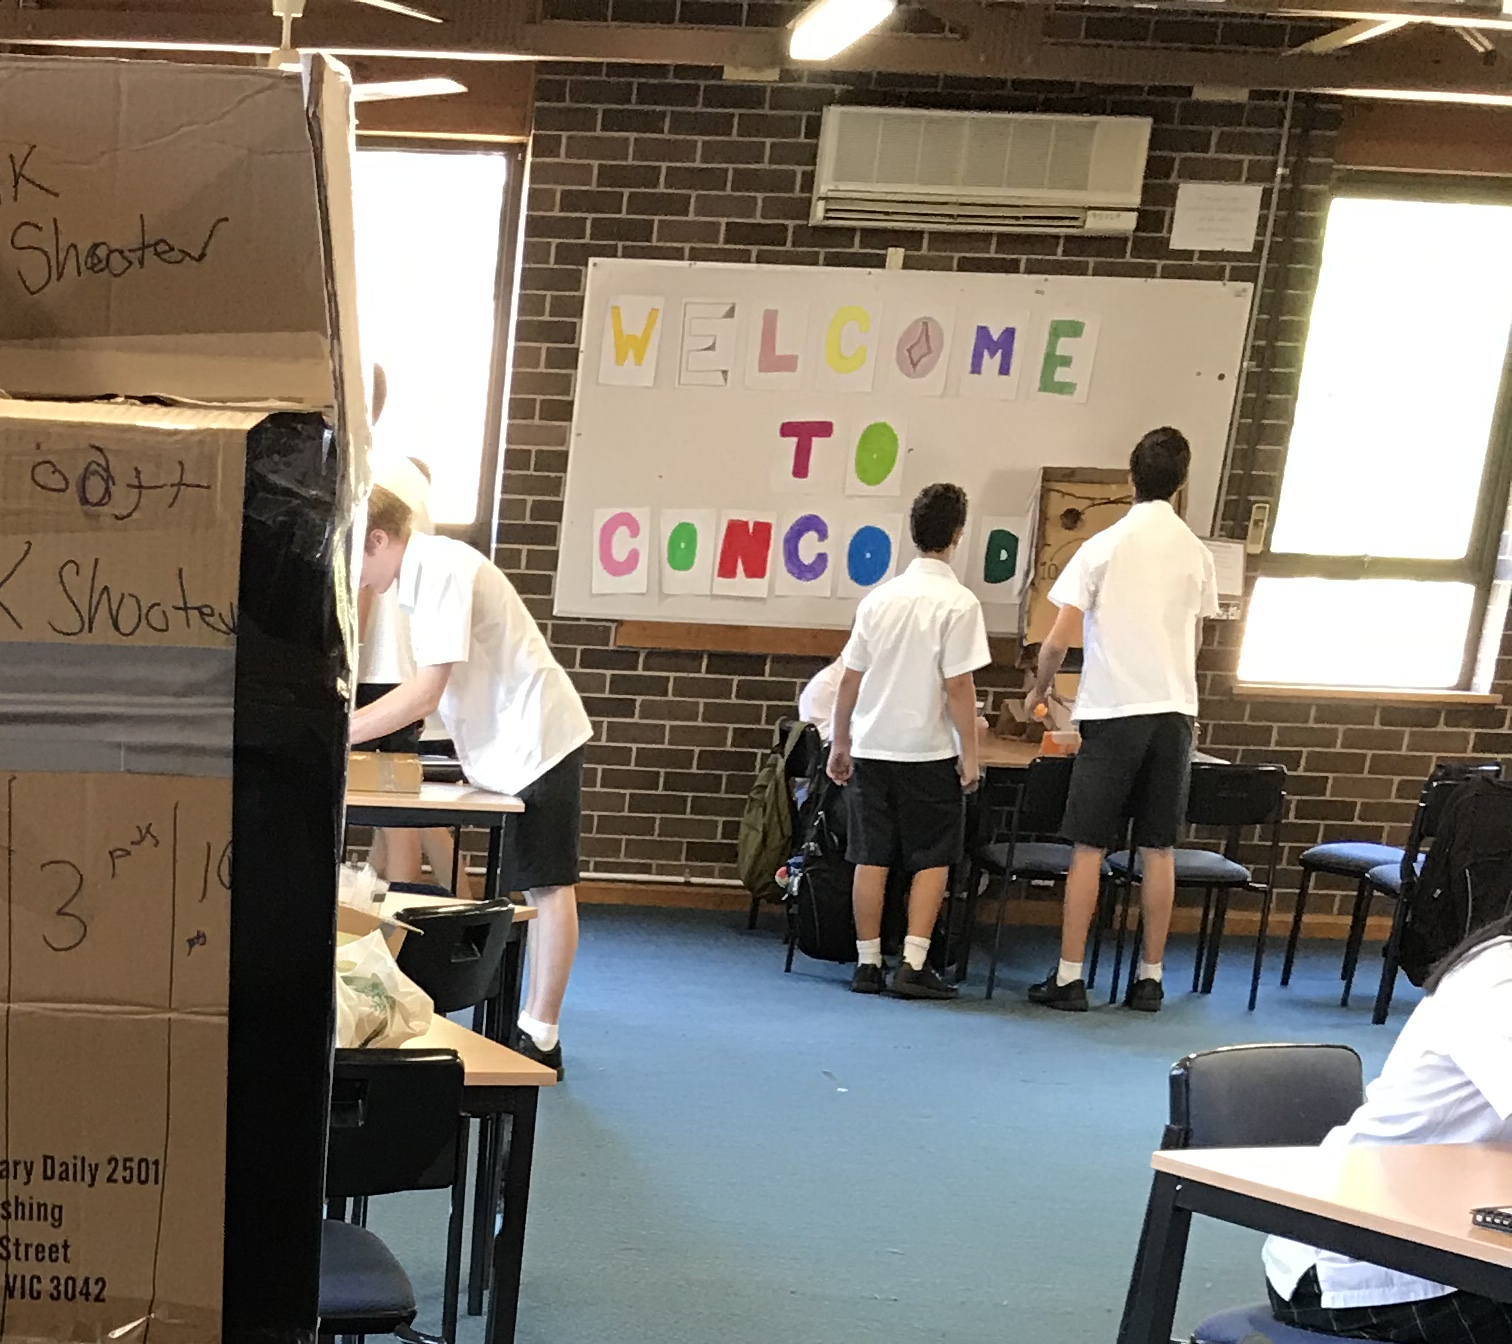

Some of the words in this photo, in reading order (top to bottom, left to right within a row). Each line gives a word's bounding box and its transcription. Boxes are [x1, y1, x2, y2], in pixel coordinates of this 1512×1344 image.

[9, 213, 230, 296] Shooter
[610, 301, 1087, 396] WELCOME
[779, 419, 900, 487] TO
[597, 510, 1020, 587] CONCOD
[39, 859, 88, 953] 3
[42, 1154, 100, 1189] Daily
[105, 1156, 161, 1186] 2501
[4, 1272, 43, 1301] VIC
[48, 1275, 107, 1303] 3042
